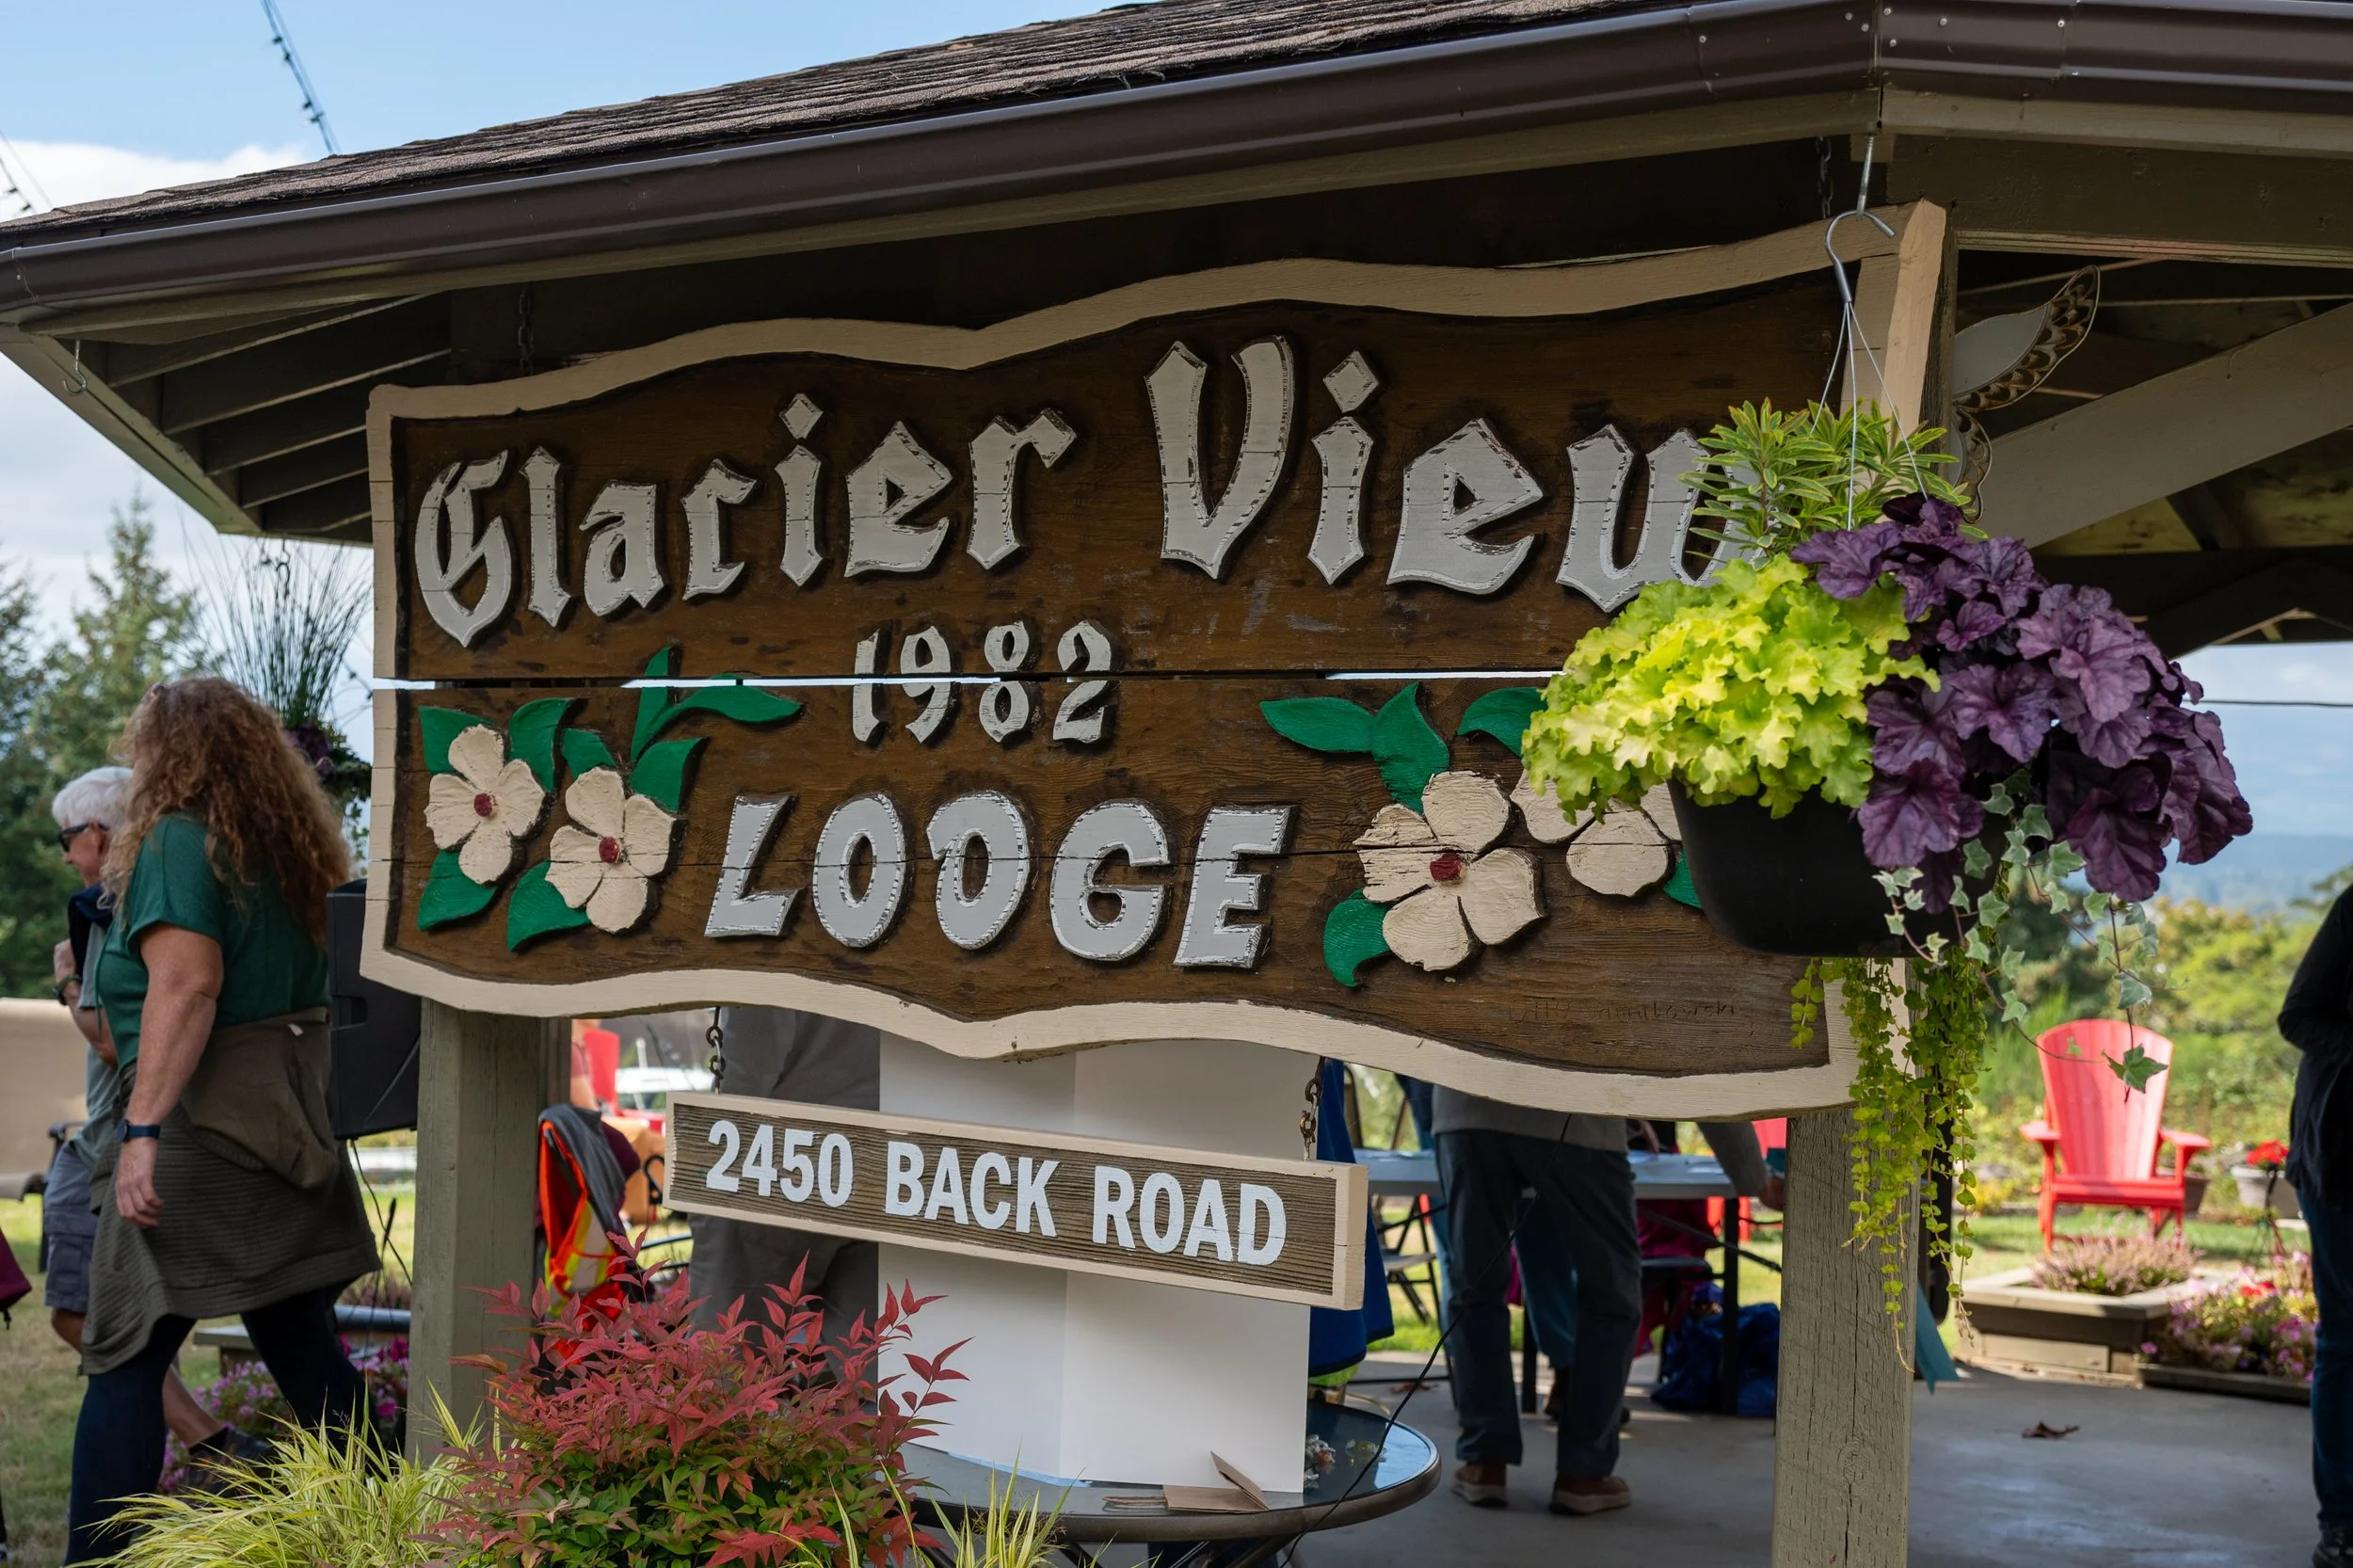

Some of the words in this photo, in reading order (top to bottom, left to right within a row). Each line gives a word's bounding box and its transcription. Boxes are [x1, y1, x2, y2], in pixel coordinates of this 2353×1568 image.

[414, 392, 1077, 648] Glacier
[1144, 335, 1775, 613] View
[853, 620, 1114, 744] 1982
[703, 790, 1299, 968] LODGE
[706, 1120, 853, 1208] 2450
[886, 1141, 1060, 1239] BACK
[1093, 1165, 1287, 1266] ROAD
